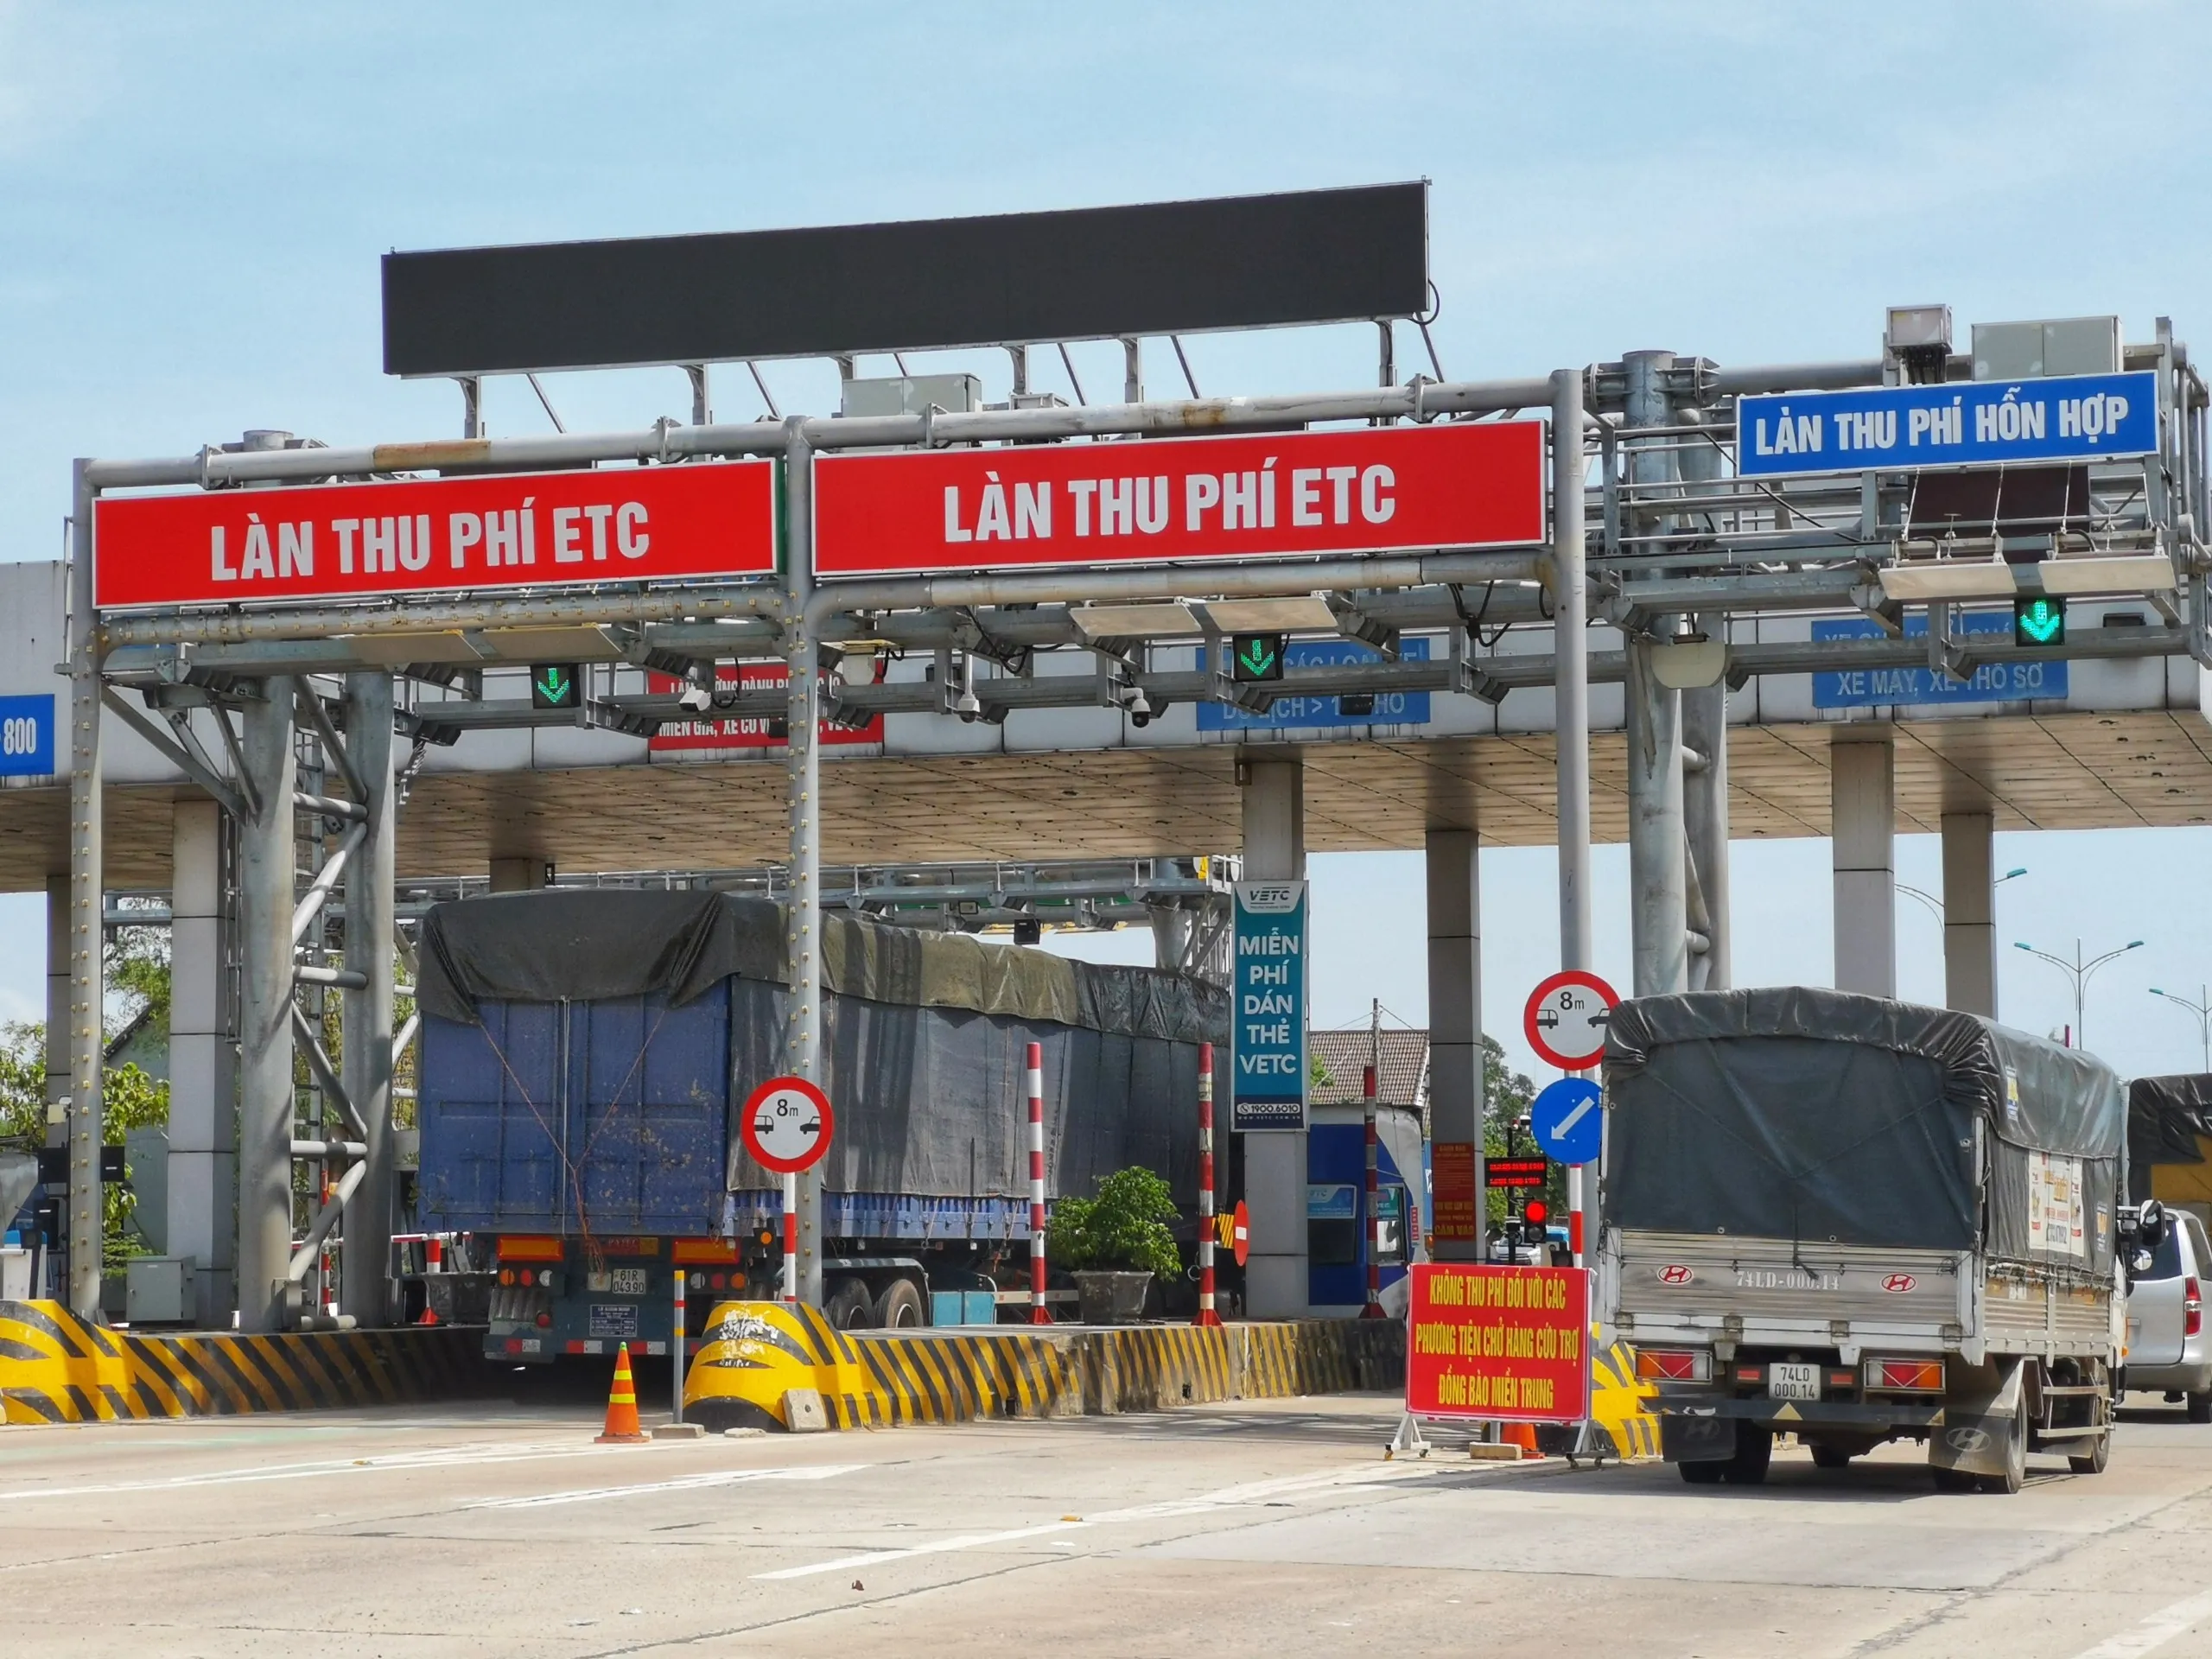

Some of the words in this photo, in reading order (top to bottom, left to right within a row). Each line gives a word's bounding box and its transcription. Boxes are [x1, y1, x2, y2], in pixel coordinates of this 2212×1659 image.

[1756, 407, 1821, 455] LÀN
[1834, 410, 1896, 450] THU
[1909, 396, 1962, 446] PHÍ
[1976, 386, 2044, 442] HỖN
[2059, 393, 2128, 444] HỢP
[944, 471, 1051, 542] LÀN
[1068, 475, 1168, 537] THU
[1185, 456, 1278, 531] PHÍ
[1292, 464, 1395, 526] ETC
[211, 513, 314, 581] LÀN
[332, 514, 430, 574] THU
[449, 496, 536, 569] PHÍ
[552, 501, 650, 563] ETC
[1837, 672, 1866, 696] XE
[3, 717, 36, 755] 800
[1249, 890, 1290, 901] VETC
[1239, 927, 1299, 956] MIỄN
[1249, 959, 1290, 985] PHÍ
[1244, 988, 1293, 1014] DÁN
[1246, 1017, 1290, 1045] THẺ
[1239, 1054, 1297, 1075] VETC
[1429, 1268, 1465, 1306] KHÔNG
[1465, 1275, 1485, 1306] THU
[1487, 1270, 1505, 1307] PHÍ
[1526, 1272, 1543, 1309] VỚI
[1545, 1273, 1567, 1310] CÁC
[1414, 1321, 1457, 1356] PHƯƠNG
[1458, 1319, 1482, 1363] TIỆN
[1483, 1316, 1504, 1357] CHỞ
[1505, 1320, 1535, 1358] HÀNG
[1535, 1321, 1558, 1360] CỨU
[1559, 1326, 1580, 1367] TRỢ
[1780, 1366, 1810, 1382] 74LD
[1520, 1377, 1554, 1410] TRUNG
[1774, 1382, 1815, 1399] 000.14
